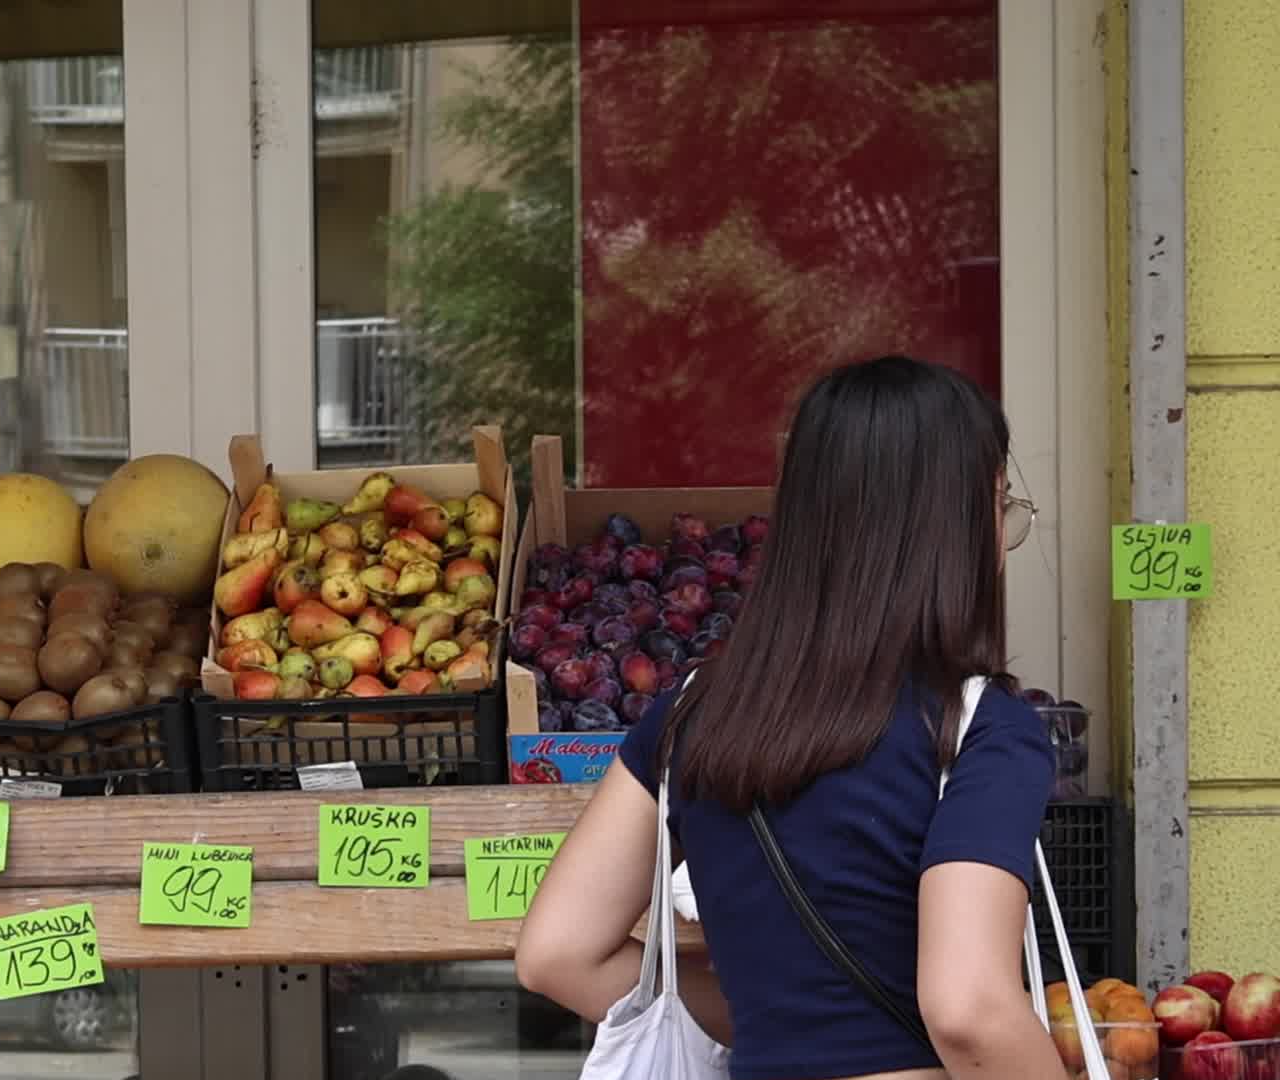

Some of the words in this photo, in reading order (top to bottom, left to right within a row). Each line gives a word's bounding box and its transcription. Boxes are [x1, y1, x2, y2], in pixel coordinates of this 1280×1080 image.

[331, 807, 417, 829] KRUŠKA
[147, 848, 180, 860] MINI
[483, 838, 554, 854] NEKTARINA
